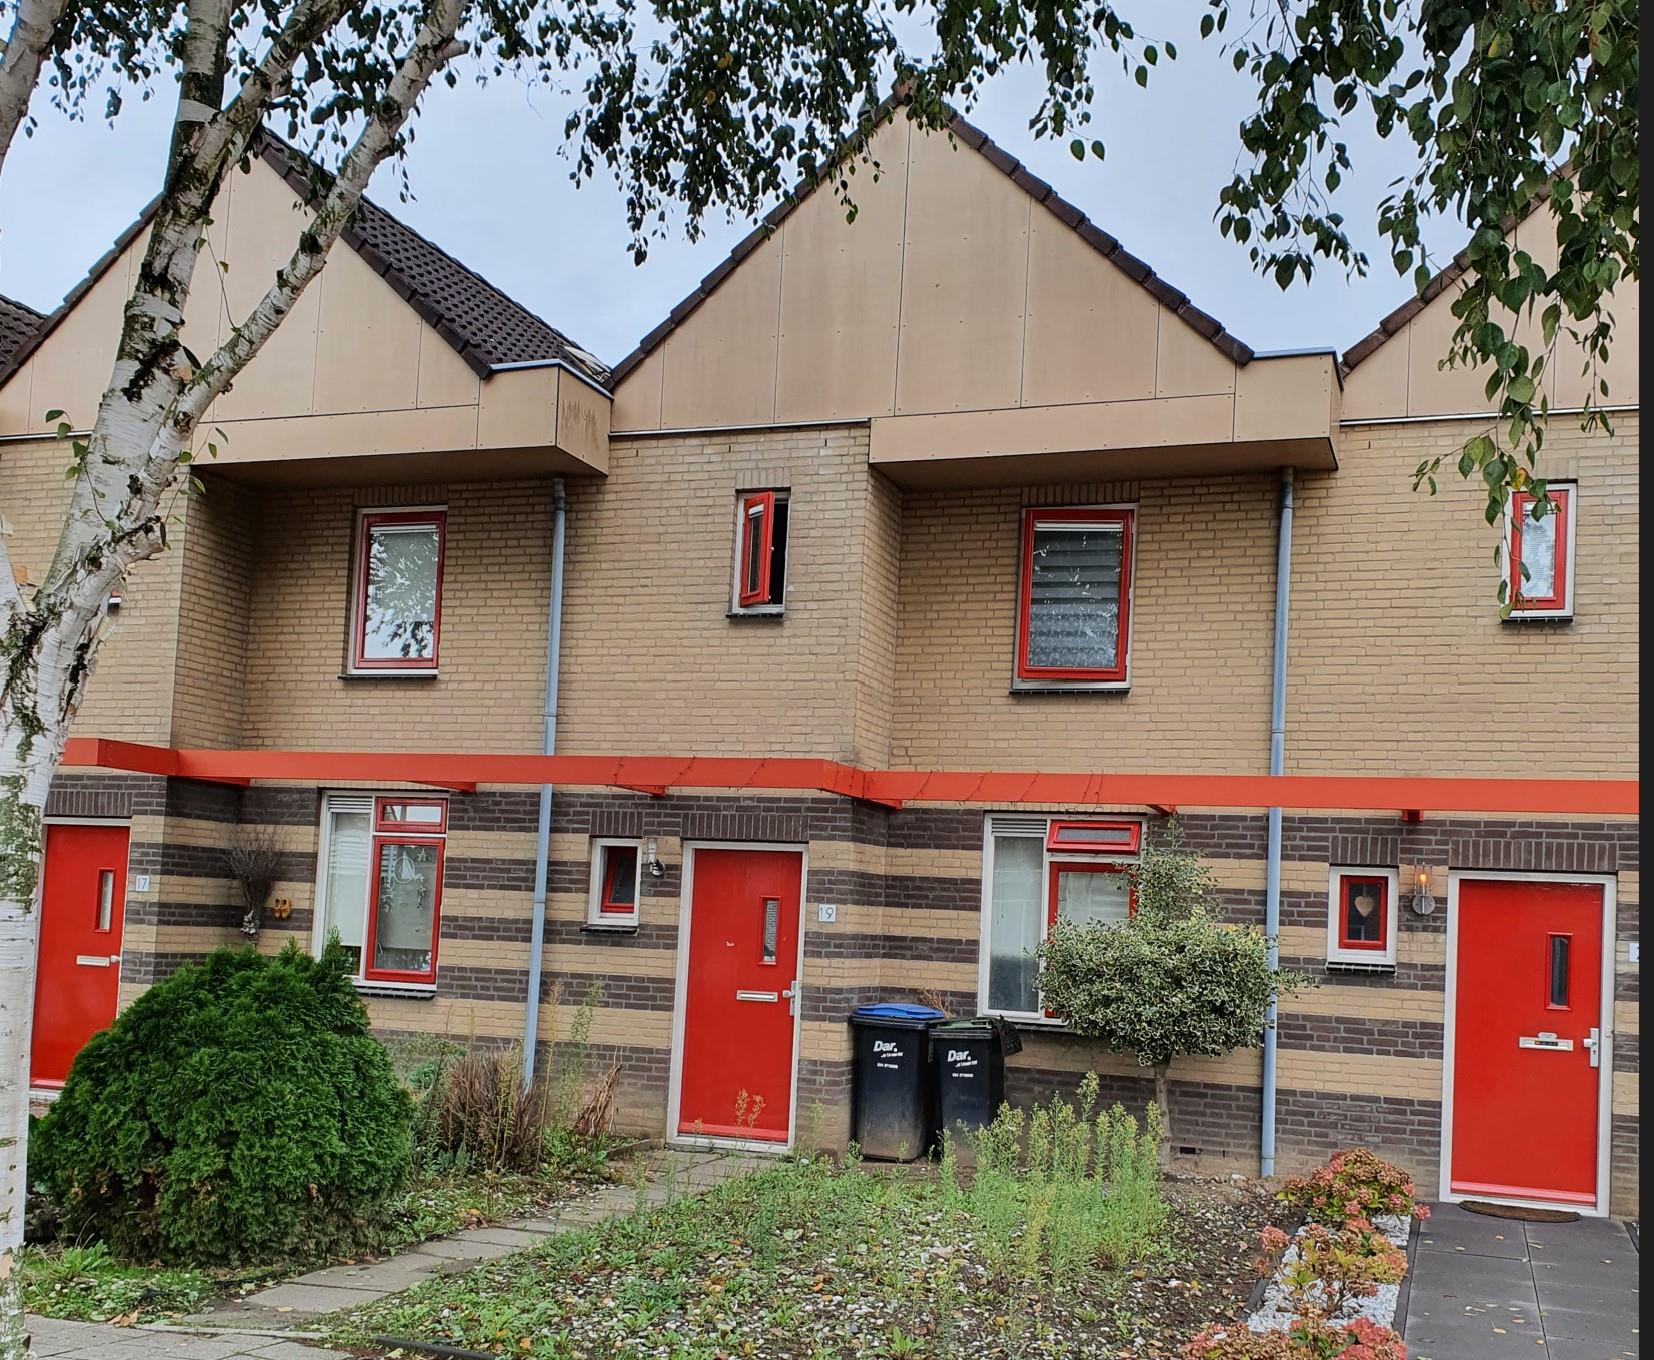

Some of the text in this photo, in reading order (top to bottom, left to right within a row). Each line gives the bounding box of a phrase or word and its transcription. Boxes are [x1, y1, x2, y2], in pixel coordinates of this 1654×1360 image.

[137, 877, 148, 889] 17
[820, 907, 834, 920] 19
[873, 1040, 898, 1052] Dar.
[947, 1049, 971, 1062] Dar.
